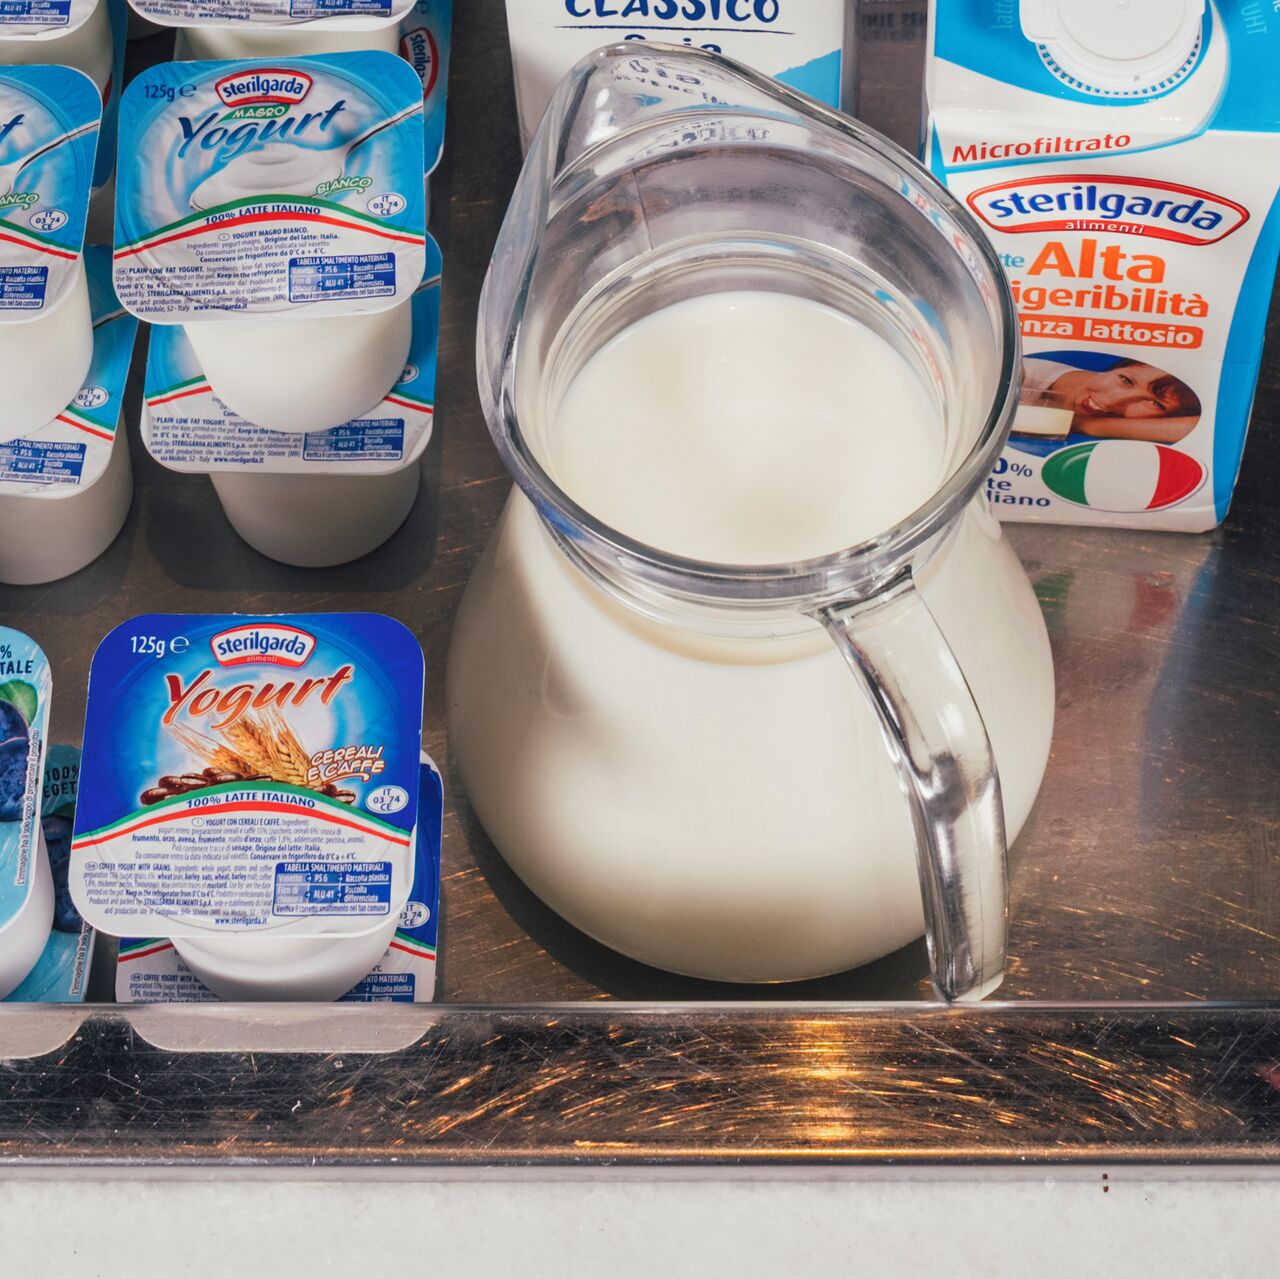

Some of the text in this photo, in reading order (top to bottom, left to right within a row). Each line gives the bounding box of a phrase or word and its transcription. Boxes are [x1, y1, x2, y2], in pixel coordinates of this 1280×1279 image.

[144, 84, 175, 101] 125g
[223, 77, 304, 98] sterilgarda
[177, 99, 346, 159] Yogurt
[951, 133, 1132, 164] Microfiltrato
[315, 176, 373, 195] BIANCO
[987, 186, 1224, 232] sterilgarda
[1065, 220, 1145, 235] alimenti
[1026, 239, 1167, 285] Alta
[1013, 279, 1209, 318] igeribilità
[1082, 319, 1195, 346] lattosio
[130, 635, 166, 659] 125g
[217, 634, 307, 657] sterilgarda
[161, 665, 353, 731] Yogurt
[311, 745, 384, 766] CEREALI
[186, 792, 316, 809] 100% LATTE ITALIANO
